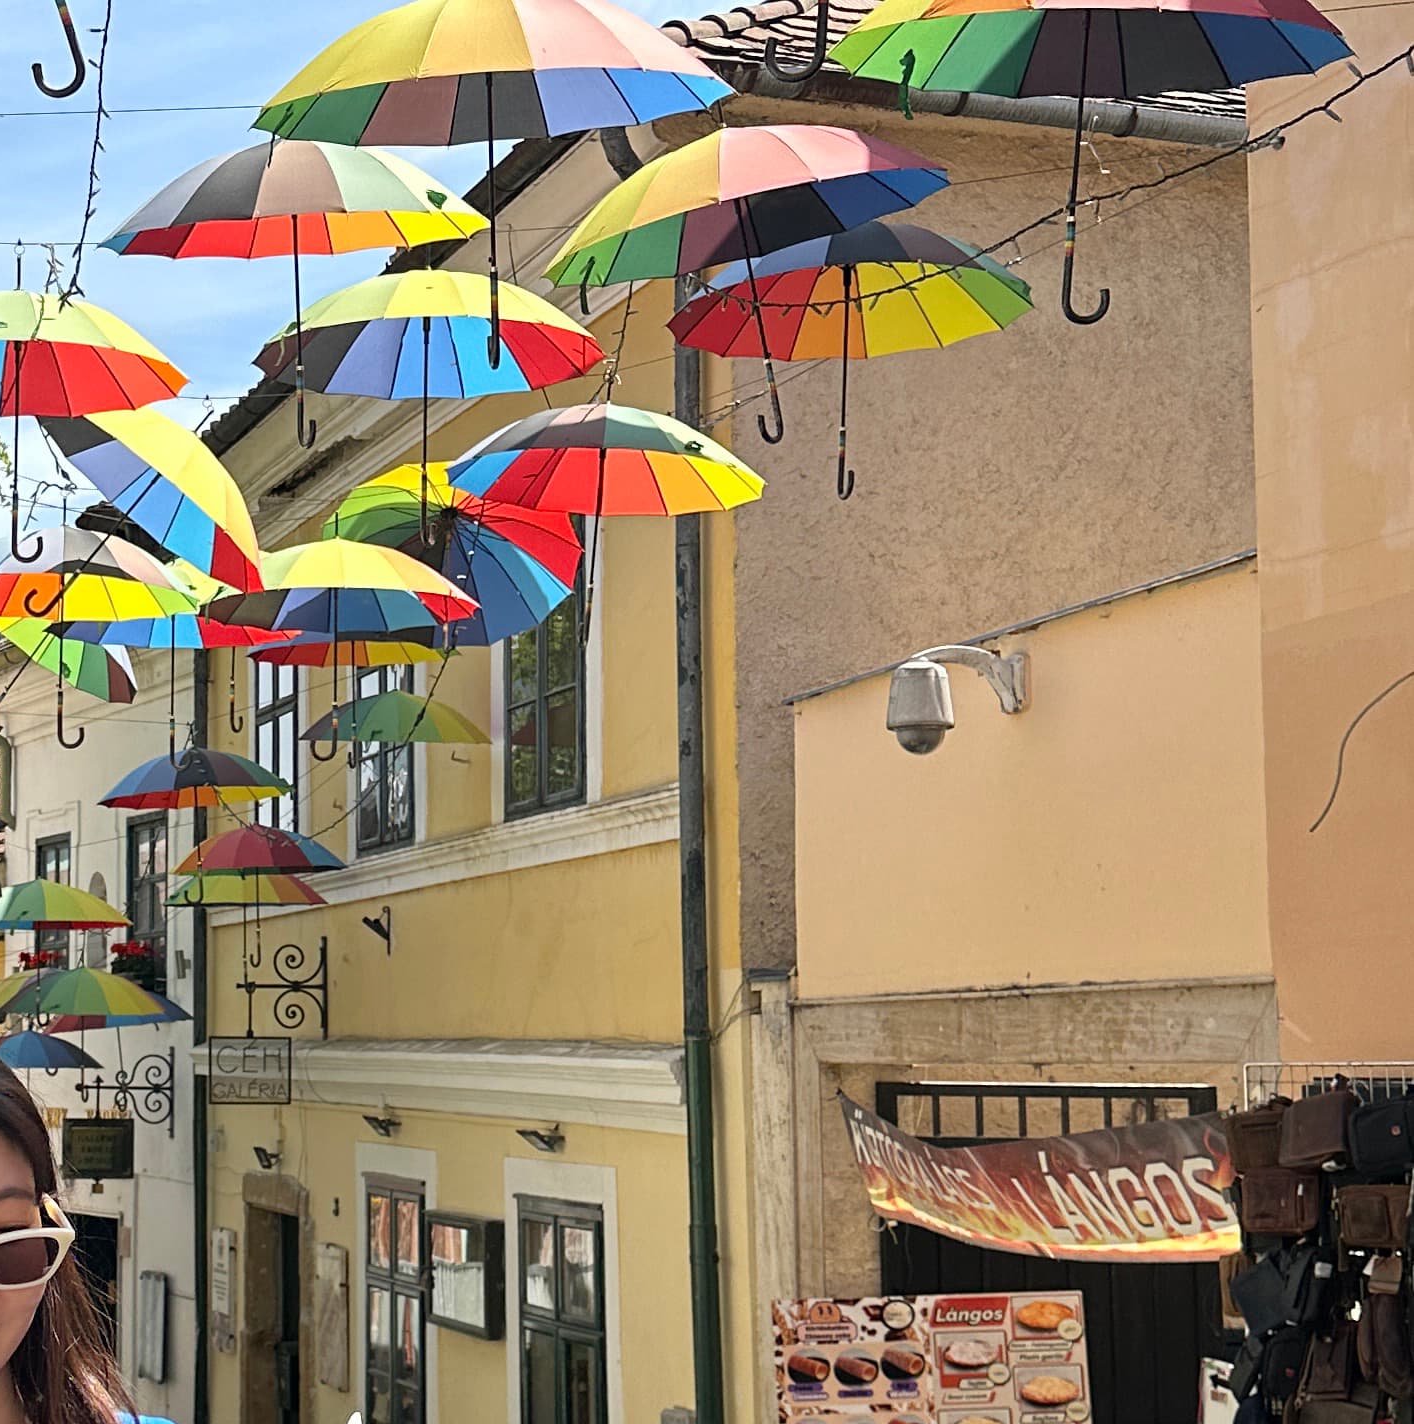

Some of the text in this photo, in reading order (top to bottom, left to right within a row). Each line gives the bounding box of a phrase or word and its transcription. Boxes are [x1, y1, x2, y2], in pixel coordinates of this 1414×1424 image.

[216, 1039, 283, 1074] CÉH
[211, 1078, 287, 1099] GALÉRIA
[1010, 1150, 1239, 1243] LÁNGOS
[936, 1306, 1003, 1325] Lángos
